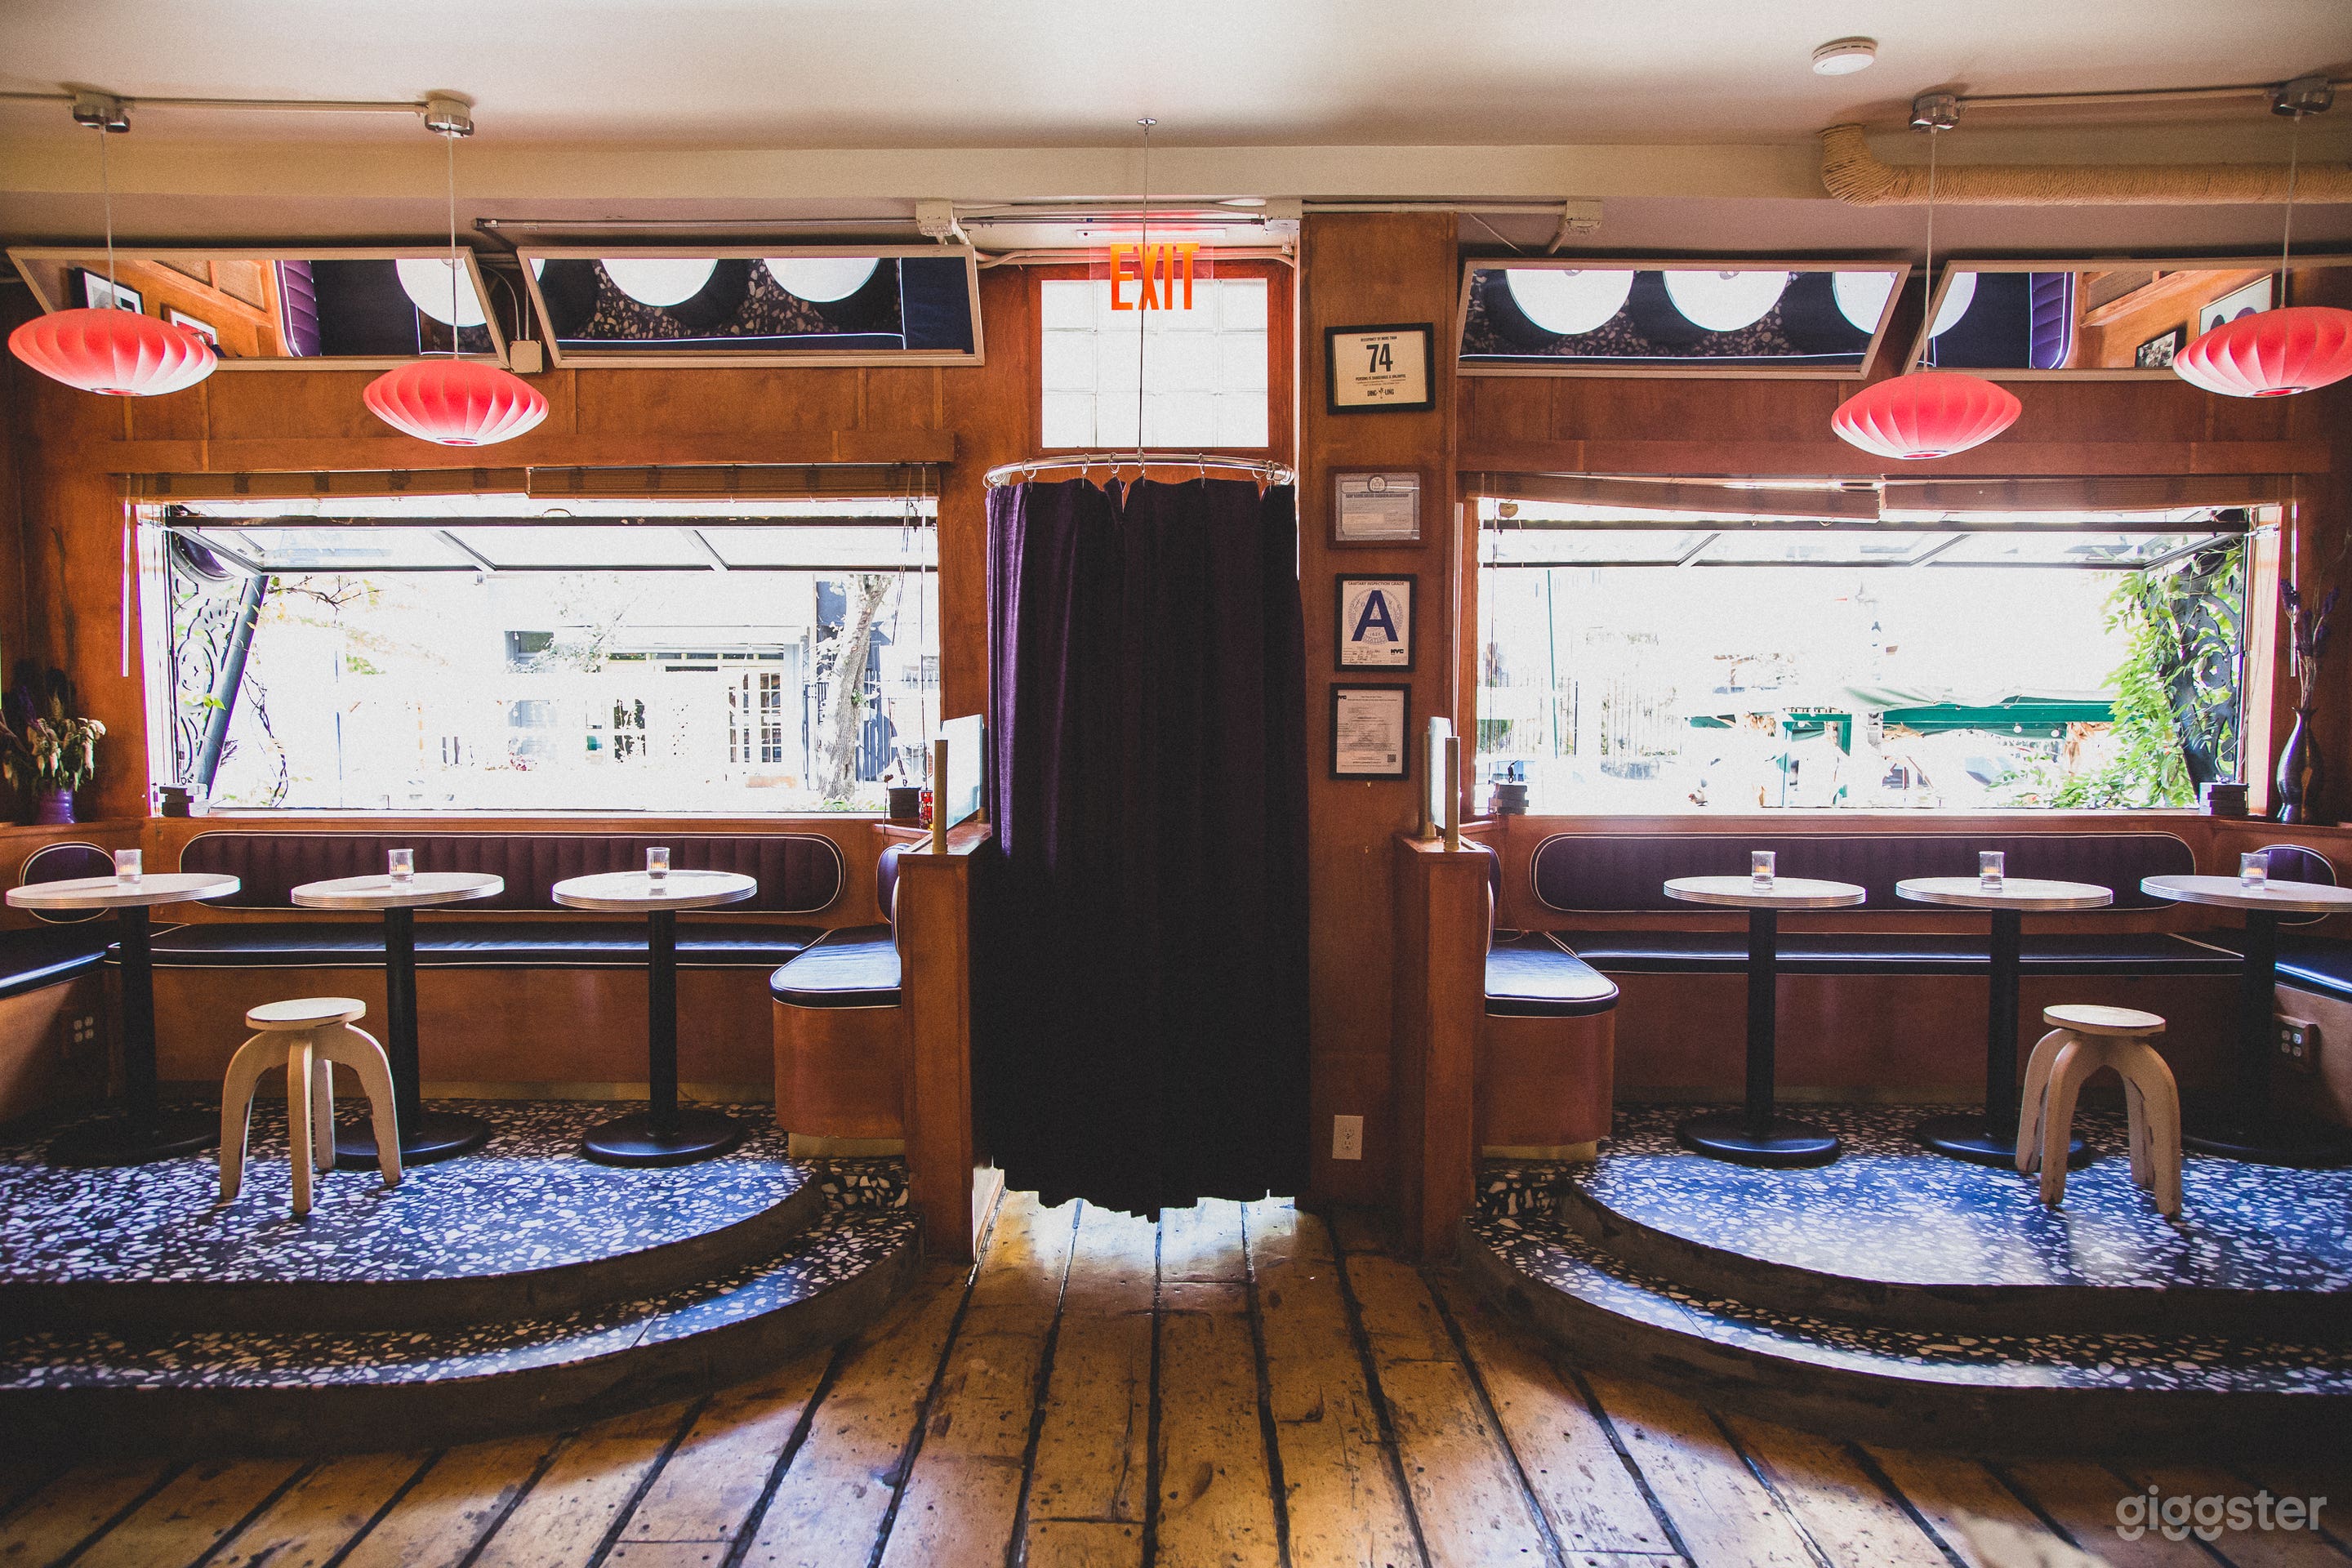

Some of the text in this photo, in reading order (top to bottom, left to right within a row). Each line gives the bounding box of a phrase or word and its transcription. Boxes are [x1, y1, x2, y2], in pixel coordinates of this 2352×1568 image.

[1109, 241, 1200, 310] EXIT
[1366, 343, 1393, 373] 74
[1351, 590, 1399, 642] A
